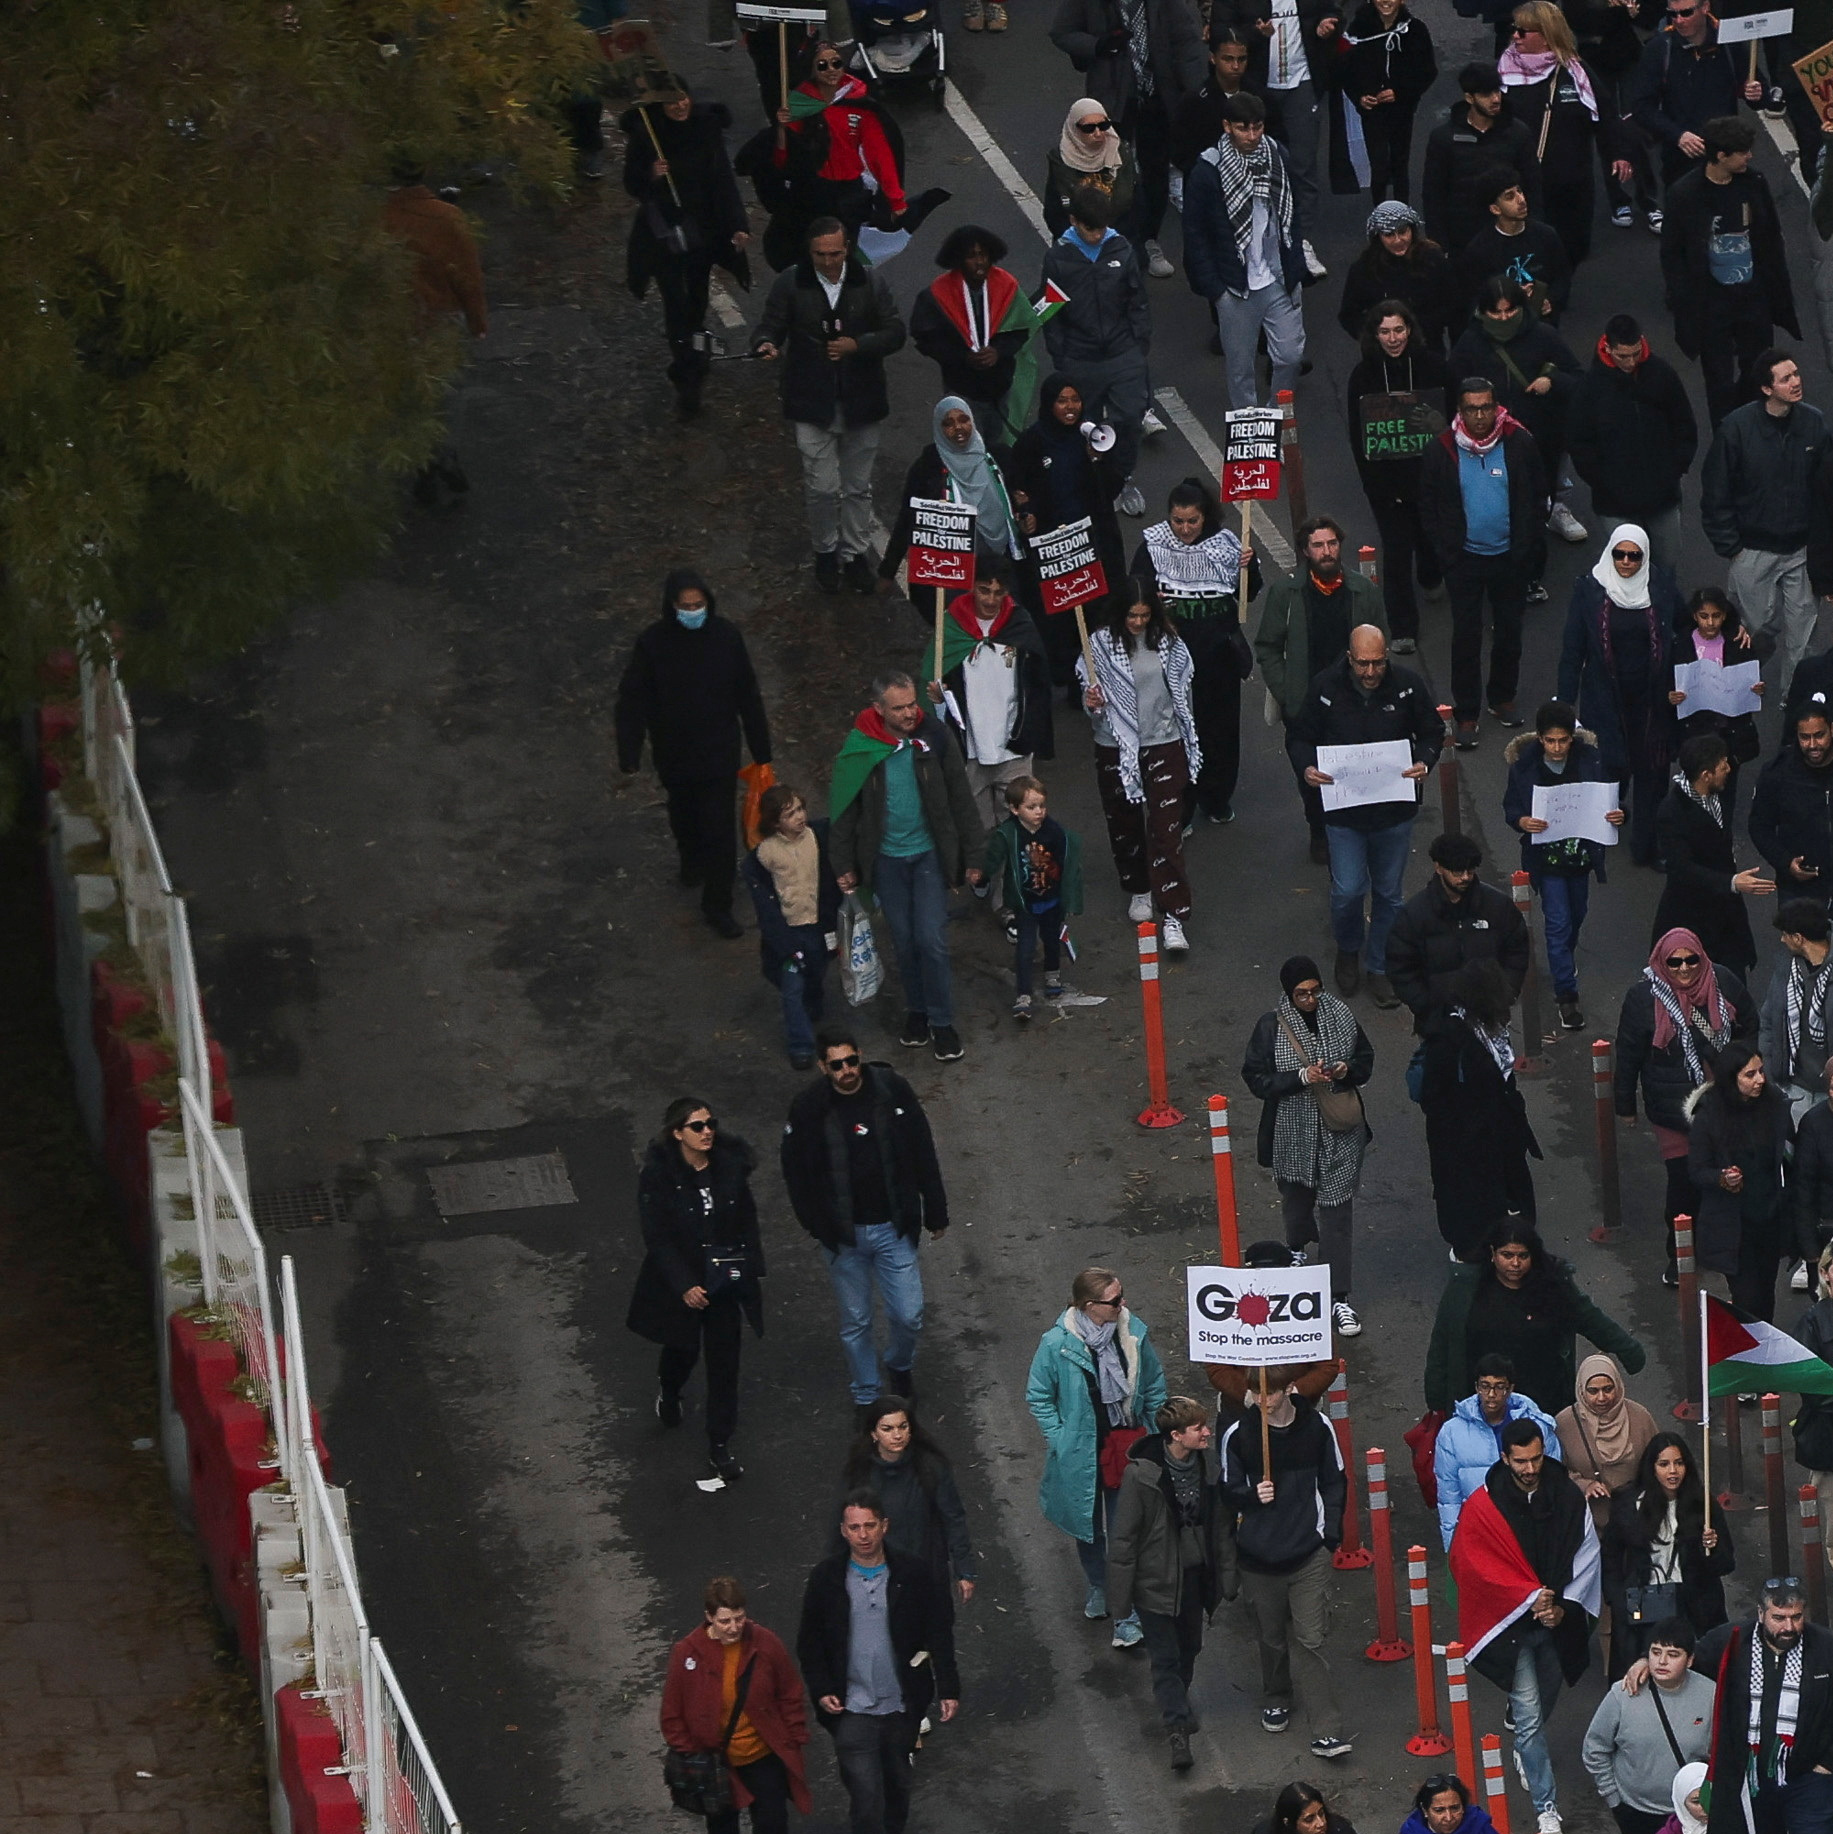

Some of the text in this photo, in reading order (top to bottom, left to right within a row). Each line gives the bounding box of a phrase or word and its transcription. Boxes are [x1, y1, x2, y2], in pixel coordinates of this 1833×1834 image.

[1230, 421, 1276, 440] FREEDOM
[1366, 418, 1407, 435] FREE
[1227, 443, 1277, 462] PALESTINE
[1366, 433, 1435, 455] PALESTI
[1233, 463, 1265, 480] الحرية
[1228, 477, 1271, 495] لفلسطين
[916, 511, 970, 531] FREEDOM
[912, 530, 972, 551] PALESTINE
[1038, 530, 1089, 560] FREEDOM
[921, 551, 961, 567] الحرية
[1039, 547, 1097, 579] PALESTINE
[915, 565, 967, 582] لفلسطين
[1054, 570, 1091, 590] الحرية
[1052, 581, 1099, 607] لفلسطين
[1196, 1283, 1322, 1322] Gza
[1198, 1330, 1323, 1346] Stop the massacre
